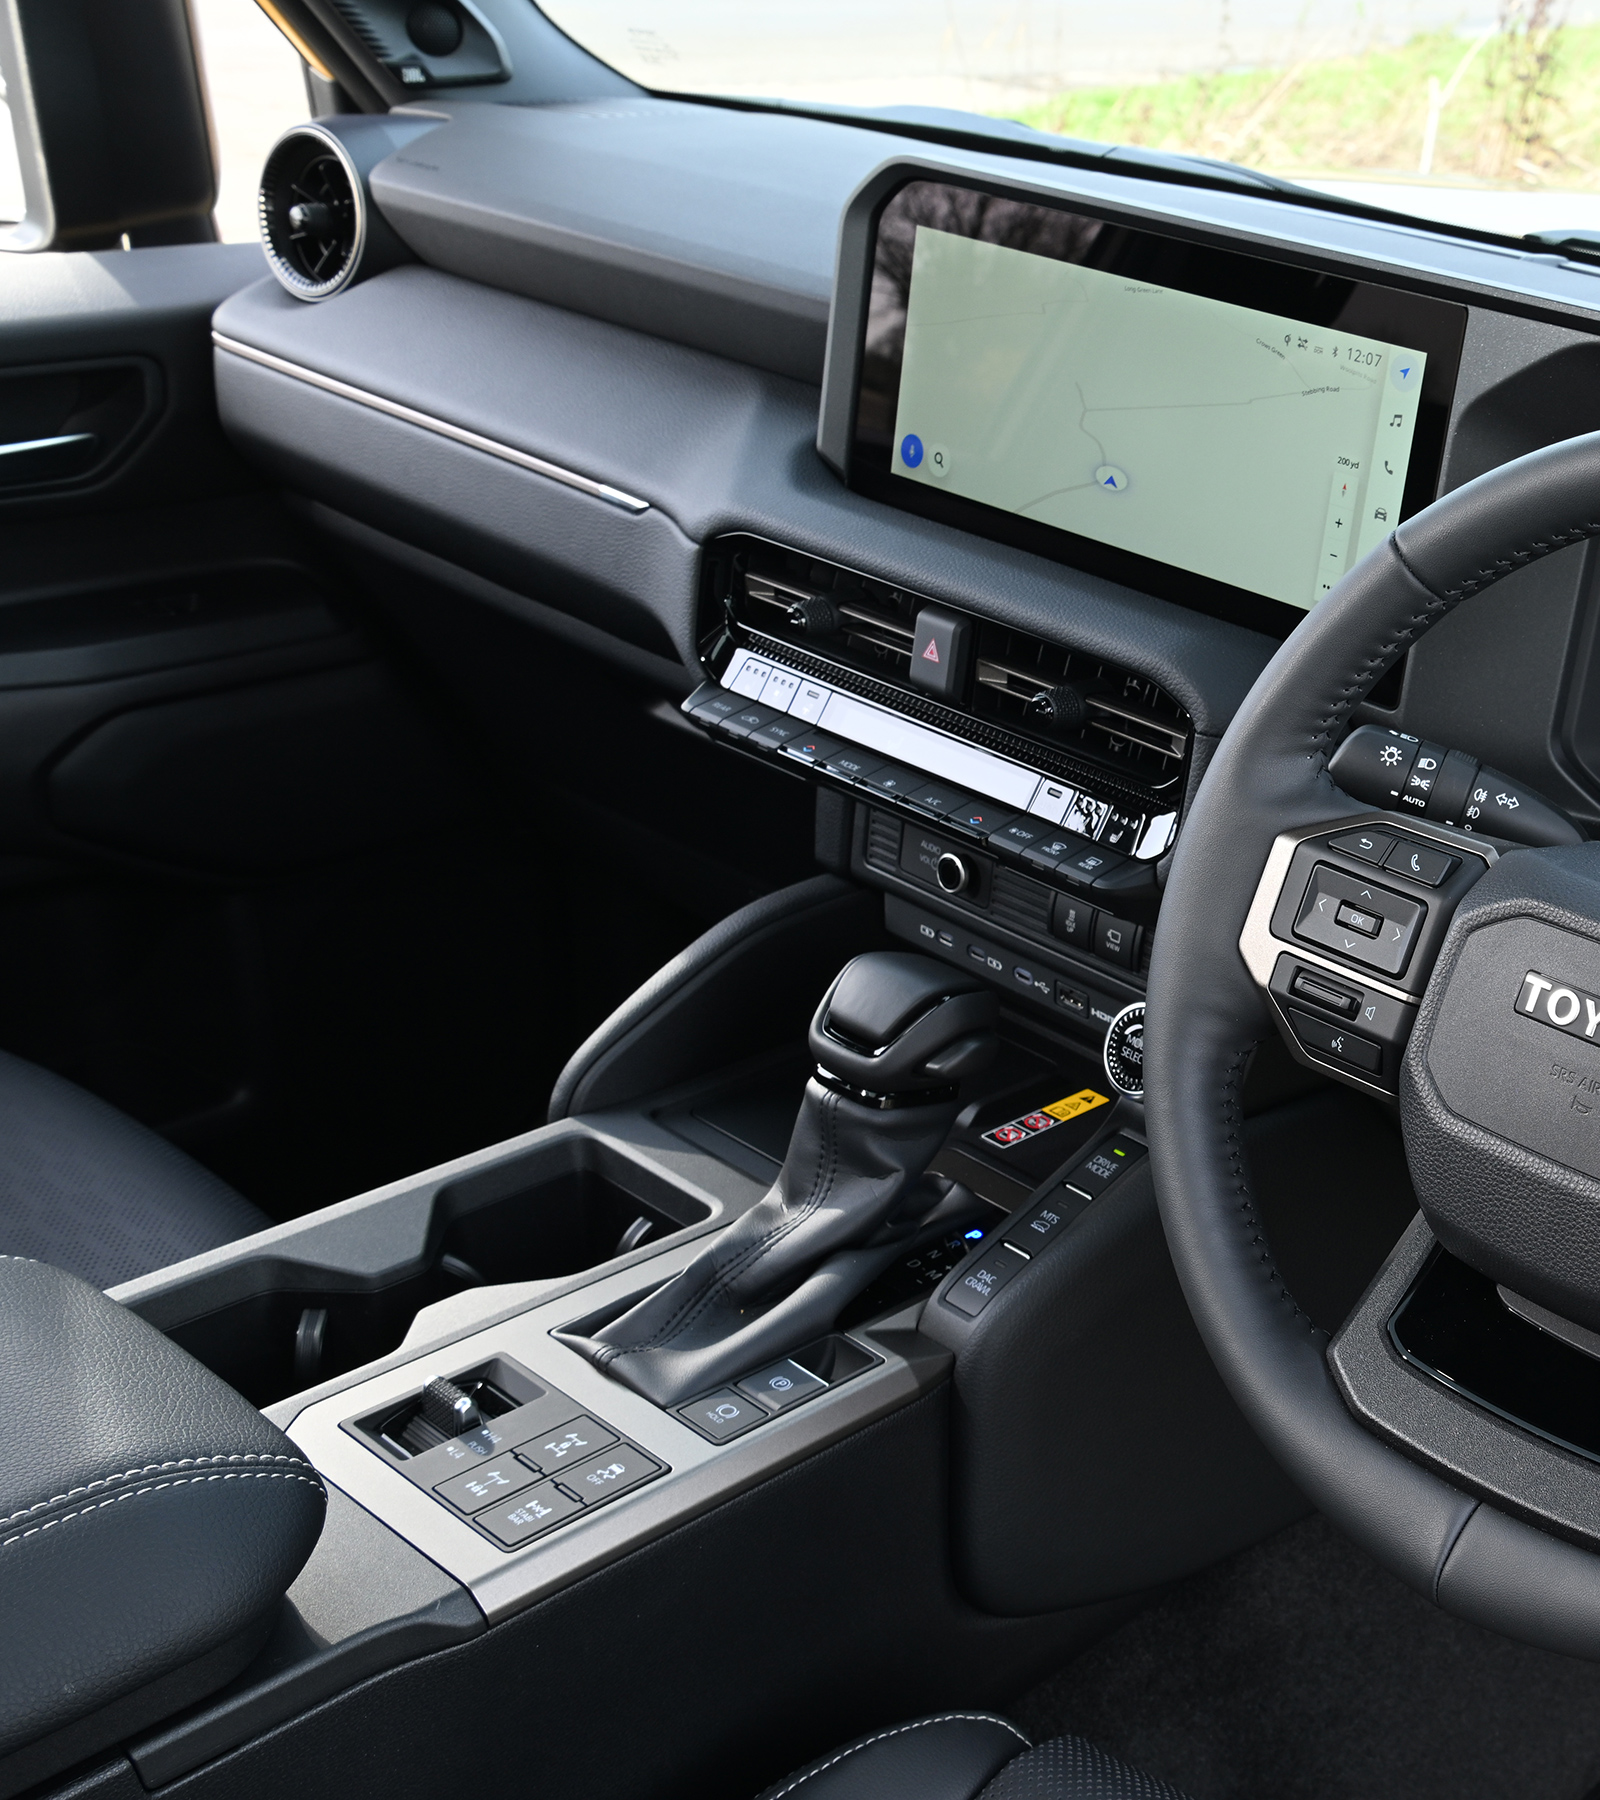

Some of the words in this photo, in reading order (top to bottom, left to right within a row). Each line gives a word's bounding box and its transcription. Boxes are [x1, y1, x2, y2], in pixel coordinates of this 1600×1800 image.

[1270, 345, 1286, 360] Green
[1347, 347, 1383, 368] 12:07
[1301, 387, 1326, 397] Stebbing
[1326, 385, 1340, 394] Road
[1337, 456, 1351, 467] 200
[1350, 461, 1360, 470] yd
[711, 702, 732, 713] REAR
[769, 726, 790, 738] SYNC
[838, 759, 861, 772] MODE
[924, 796, 942, 806] A/C
[1402, 794, 1426, 808] AUTO
[1016, 830, 1034, 841] OFF
[920, 839, 942, 856] AUDIO
[1041, 845, 1061, 857] FRONT
[1077, 861, 1094, 871] REAR
[1350, 913, 1365, 926] OK
[1105, 940, 1121, 953] VIEW
[1090, 1007, 1116, 1024] HDM
[1120, 1045, 1144, 1065] SELEC
[1550, 1063, 1577, 1085] SRS
[1084, 1161, 1114, 1180] MODE
[1092, 1154, 1119, 1173] DRIVE
[1039, 1209, 1061, 1225] MTS
[964, 1228, 984, 1240] P
[976, 1268, 998, 1285] DAC
[964, 1276, 992, 1297] CRAWL
[705, 1410, 725, 1425] HOLD
[467, 1440, 489, 1456] PUSH
[586, 1473, 605, 1486] OFF
[507, 1513, 525, 1526] BAR
